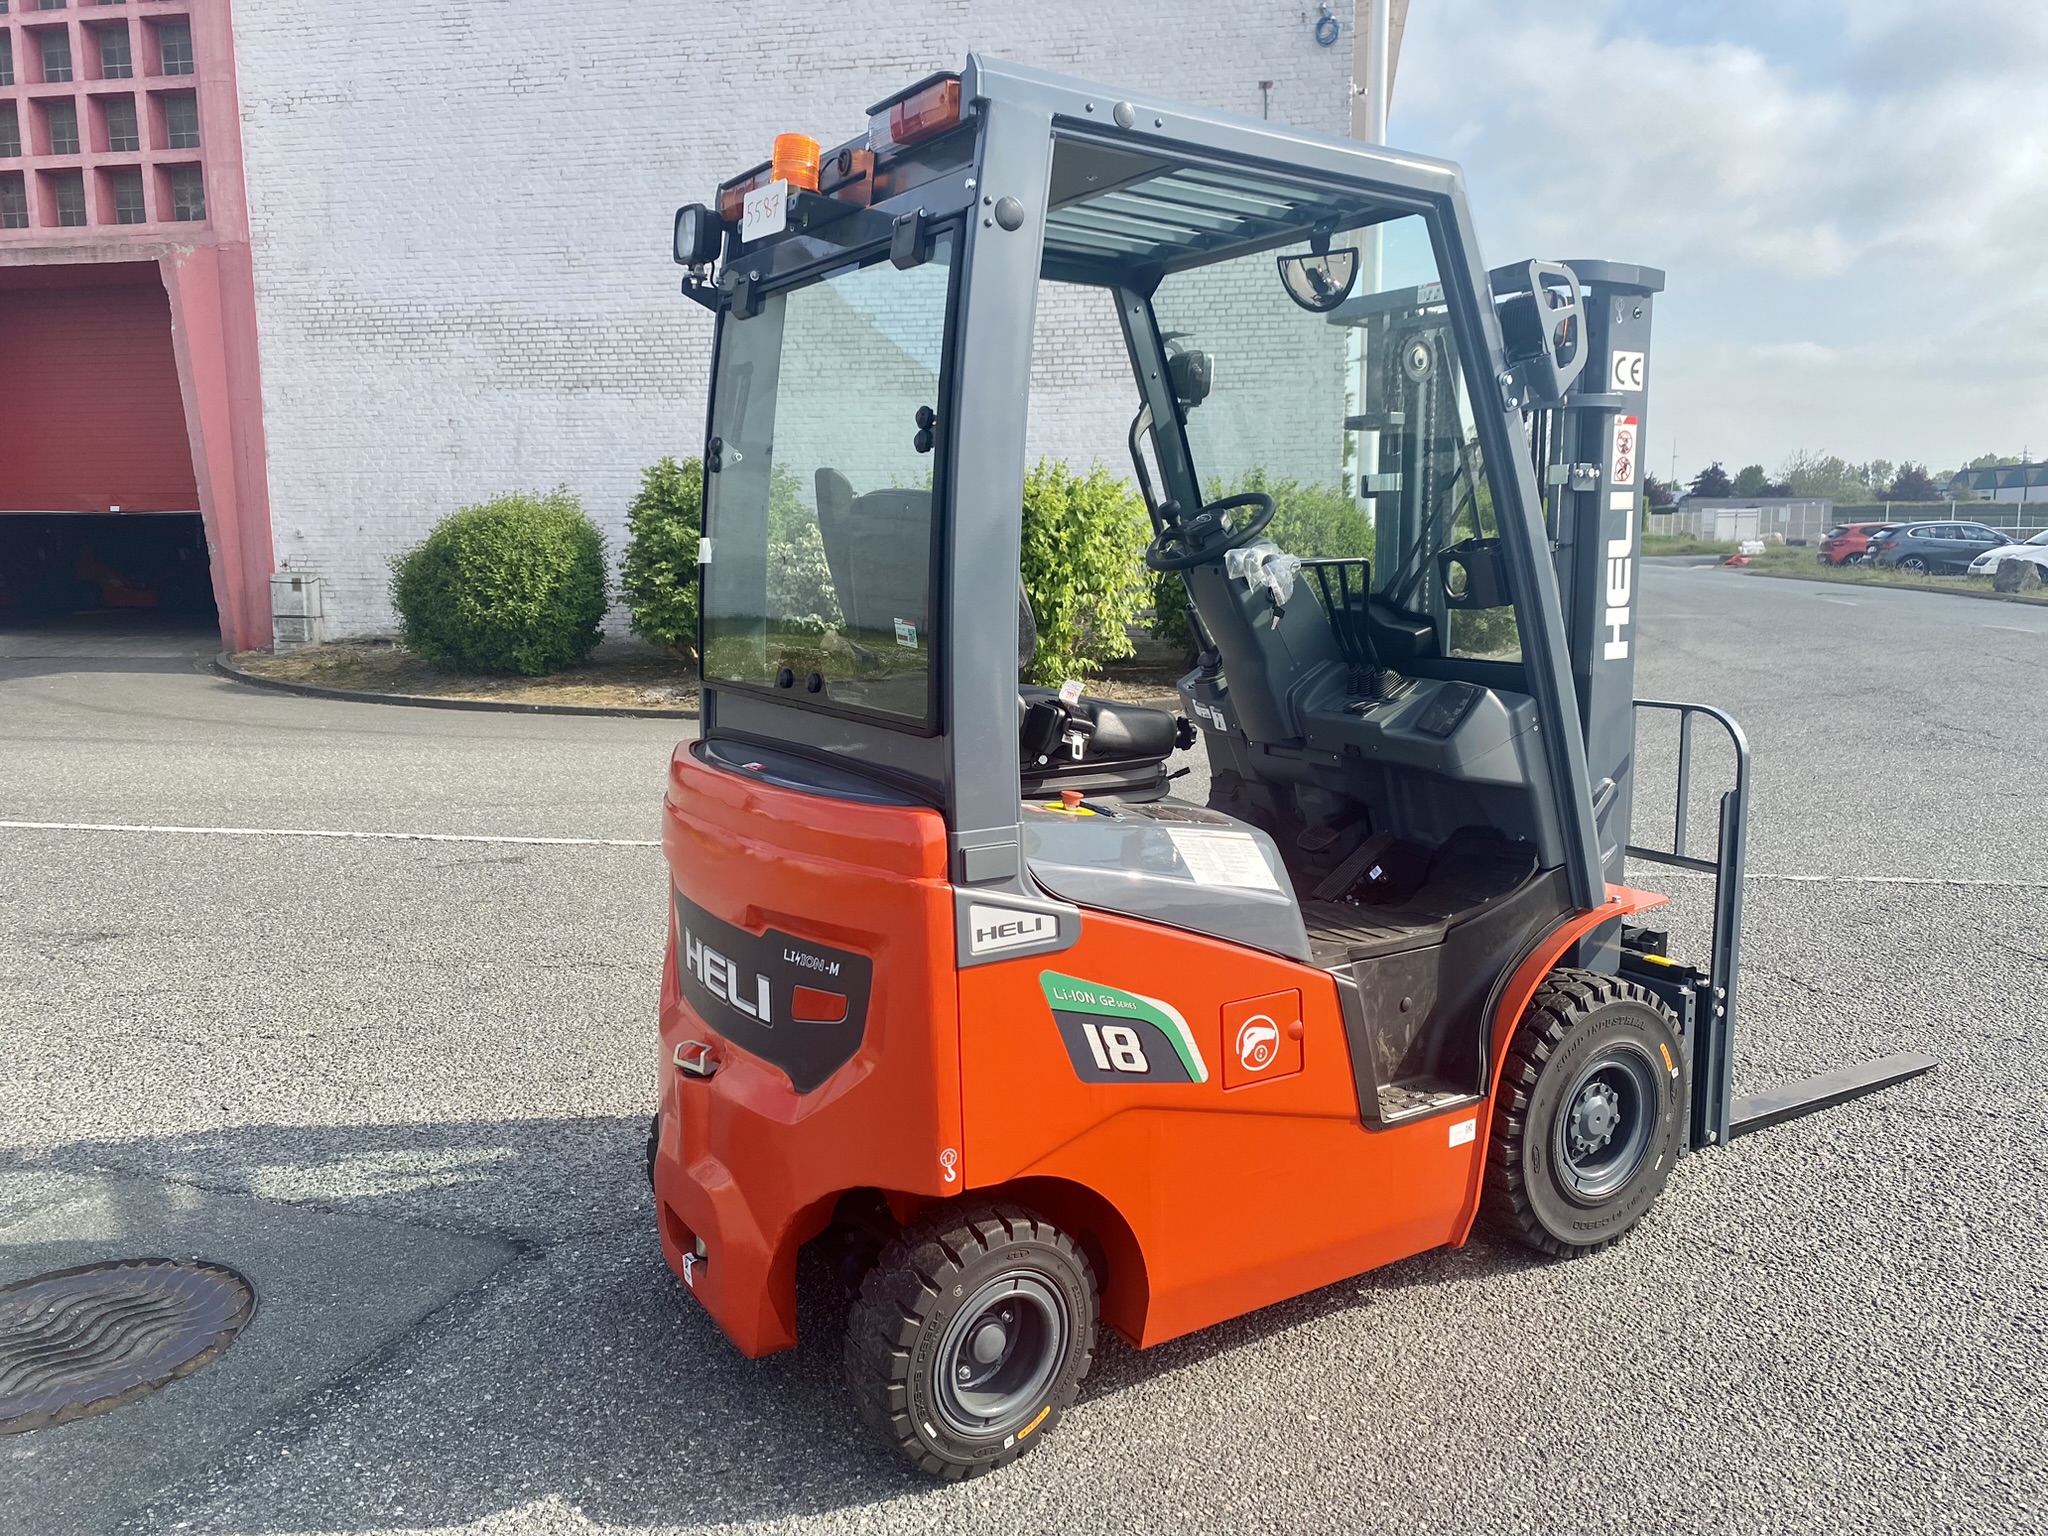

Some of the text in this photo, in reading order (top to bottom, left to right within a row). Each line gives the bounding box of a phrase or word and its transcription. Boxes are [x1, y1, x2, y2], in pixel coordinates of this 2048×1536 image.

[747, 193, 780, 228] 5587
[1615, 356, 1642, 386] CE
[1603, 491, 1635, 661] HELI
[976, 917, 1042, 943] HELI
[685, 927, 774, 1028] HELI
[1053, 987, 1097, 1005] Li-ION
[1116, 1000, 1137, 1010] SERIES
[1587, 1016, 1646, 1032] INDUSTRIAL
[1082, 1023, 1150, 1074] 18
